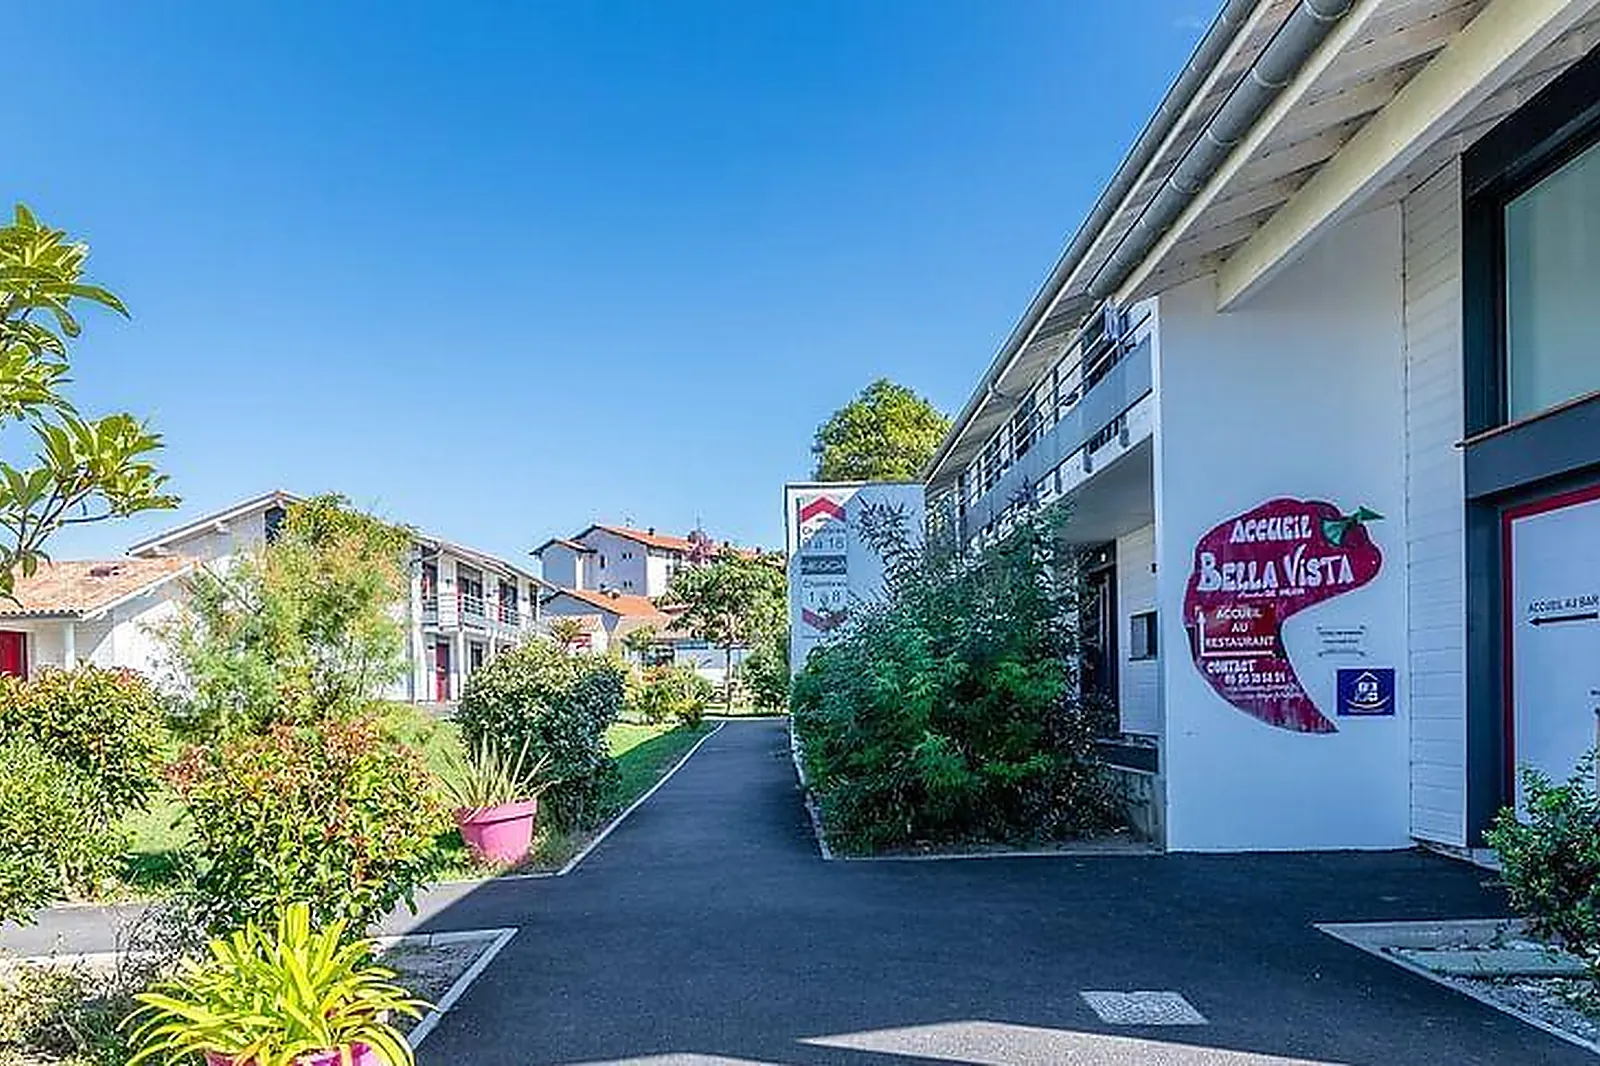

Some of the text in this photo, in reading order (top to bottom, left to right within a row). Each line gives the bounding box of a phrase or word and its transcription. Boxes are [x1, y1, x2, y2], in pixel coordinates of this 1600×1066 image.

[1196, 552, 1279, 591] BELLA
[1528, 599, 1562, 612] ACCUEIL
[1216, 608, 1263, 620] ACCUEIL
[1231, 622, 1249, 633] AU
[1206, 635, 1275, 648] RESTAURANT
[1207, 659, 1257, 674] CONTACT
